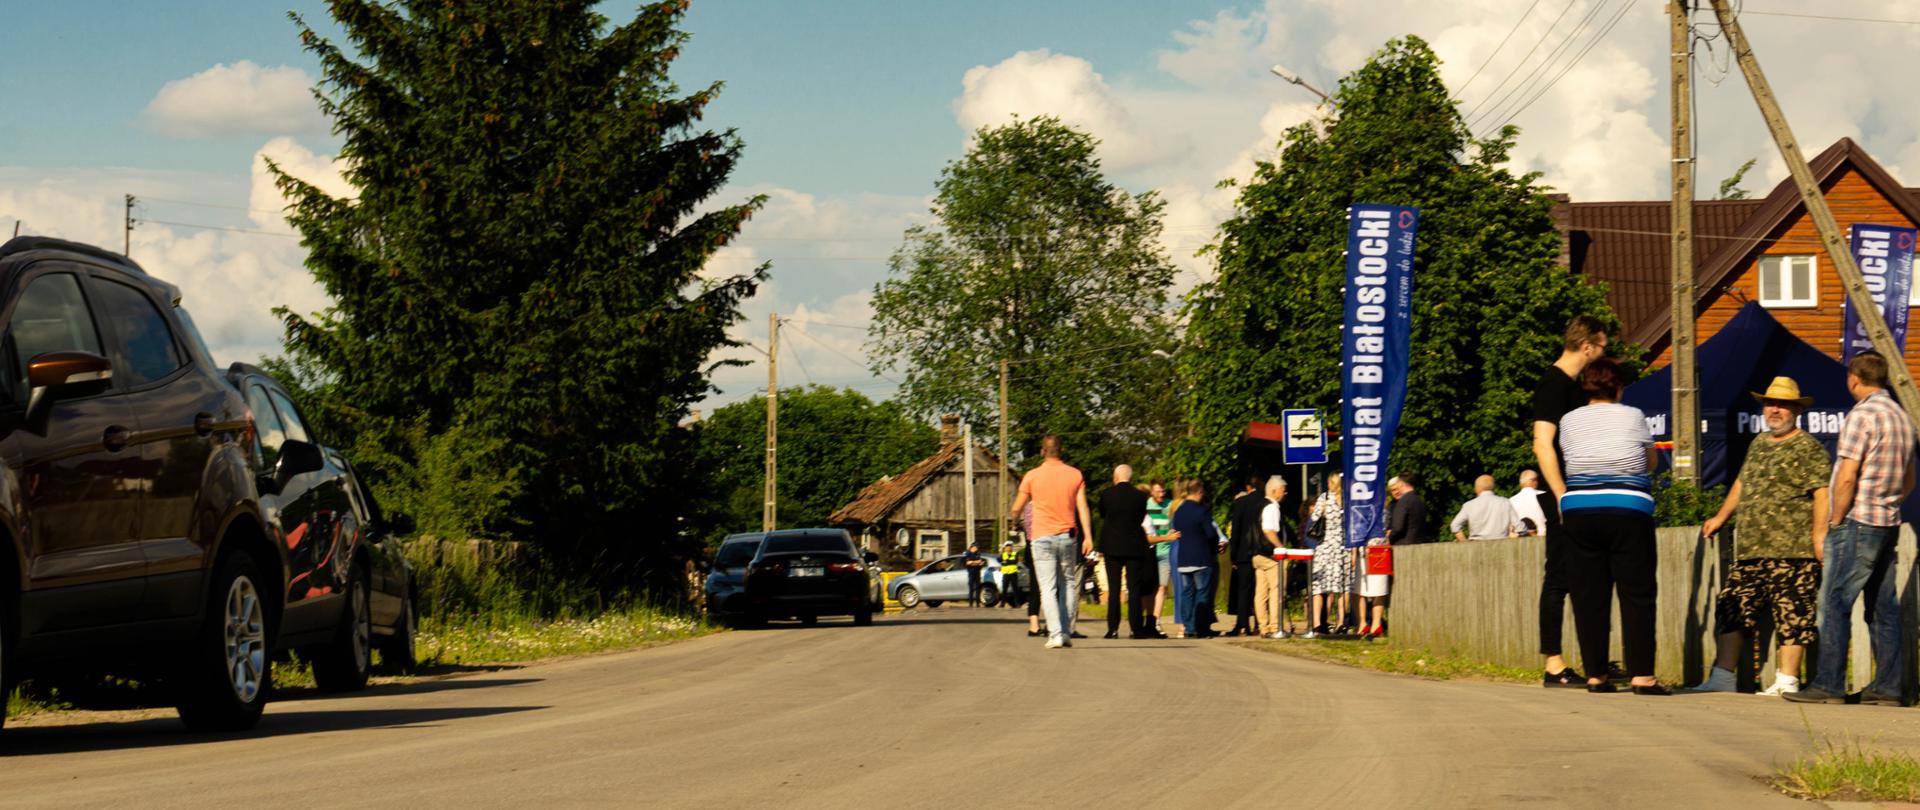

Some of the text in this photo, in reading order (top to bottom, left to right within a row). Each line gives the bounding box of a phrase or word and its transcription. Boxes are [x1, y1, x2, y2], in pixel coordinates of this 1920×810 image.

[1397, 231, 1414, 256] ludzi
[1396, 258, 1411, 272] do
[1398, 276, 1410, 308] sercem
[1350, 210, 1392, 501] Powiat Białostocki
